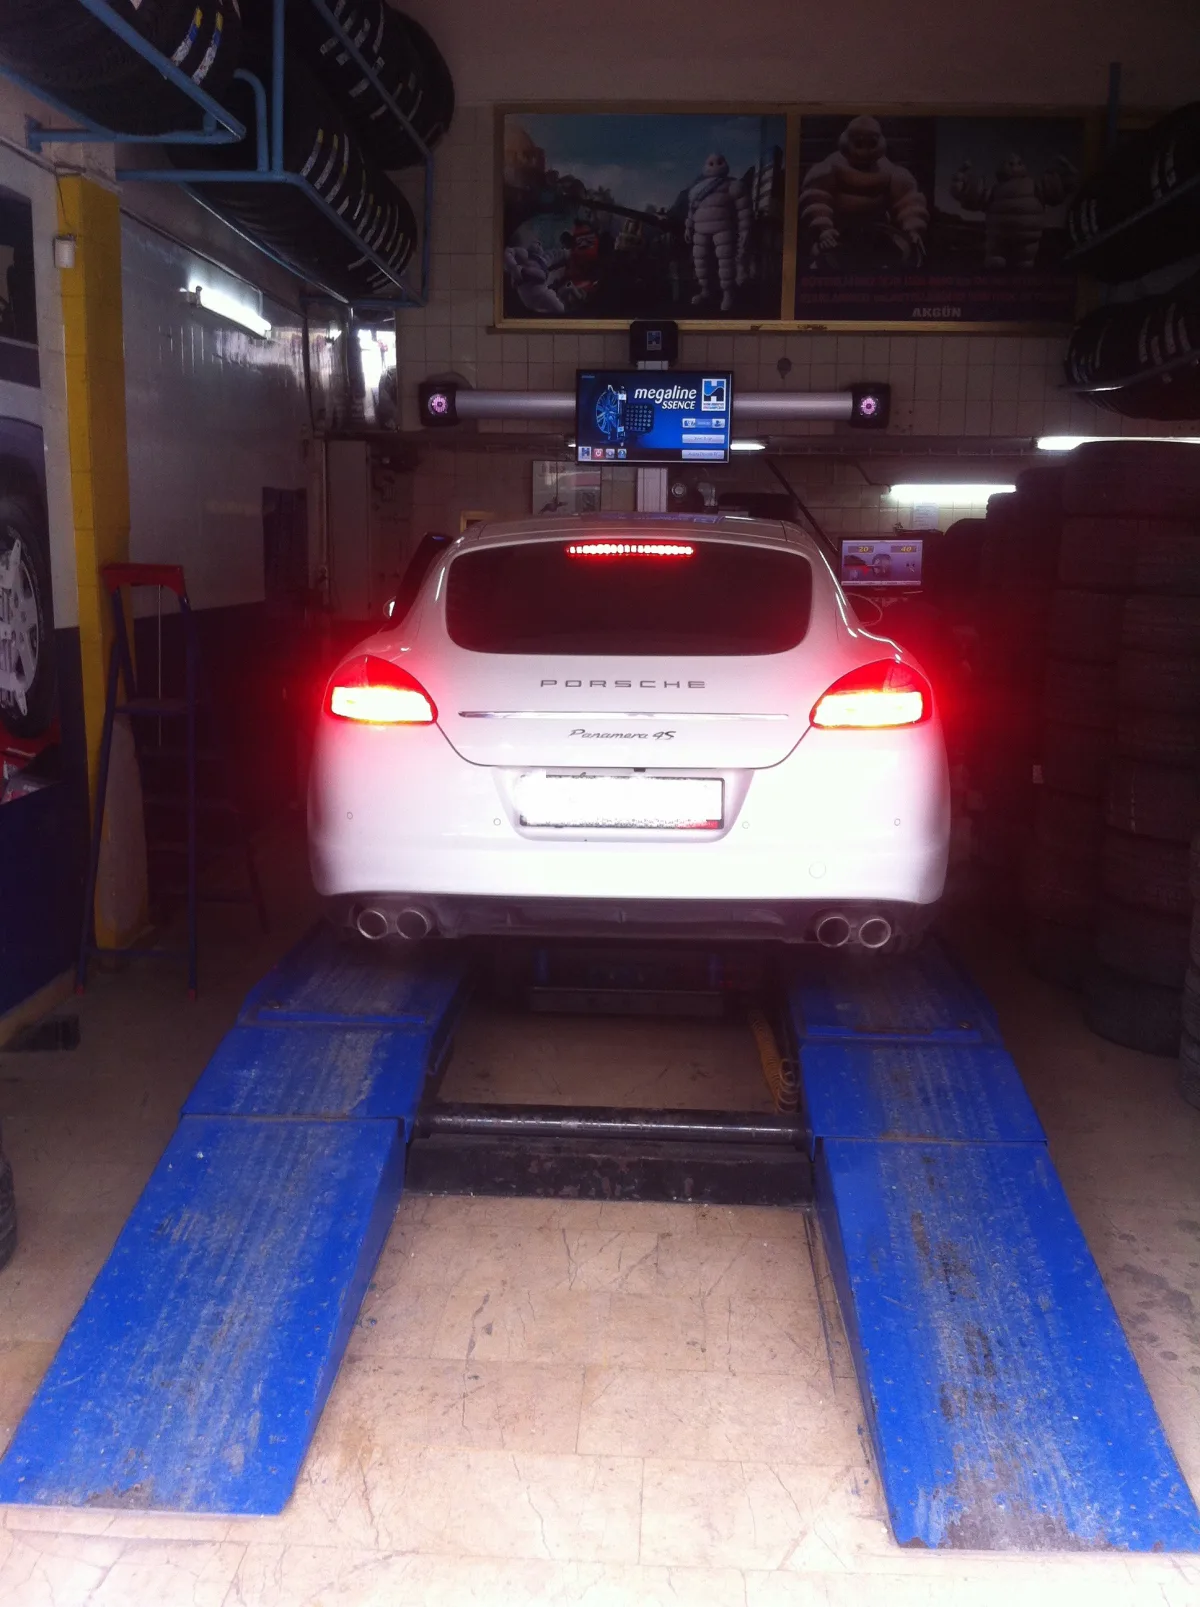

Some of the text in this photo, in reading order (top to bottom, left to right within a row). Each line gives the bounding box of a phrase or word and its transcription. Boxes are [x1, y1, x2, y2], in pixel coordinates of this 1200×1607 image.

[912, 305, 961, 318] AKGÜN
[634, 385, 697, 404] megaline
[662, 401, 695, 410] SSENCE
[540, 679, 705, 689] PORSCHE
[568, 728, 676, 740] Panamera 4S
